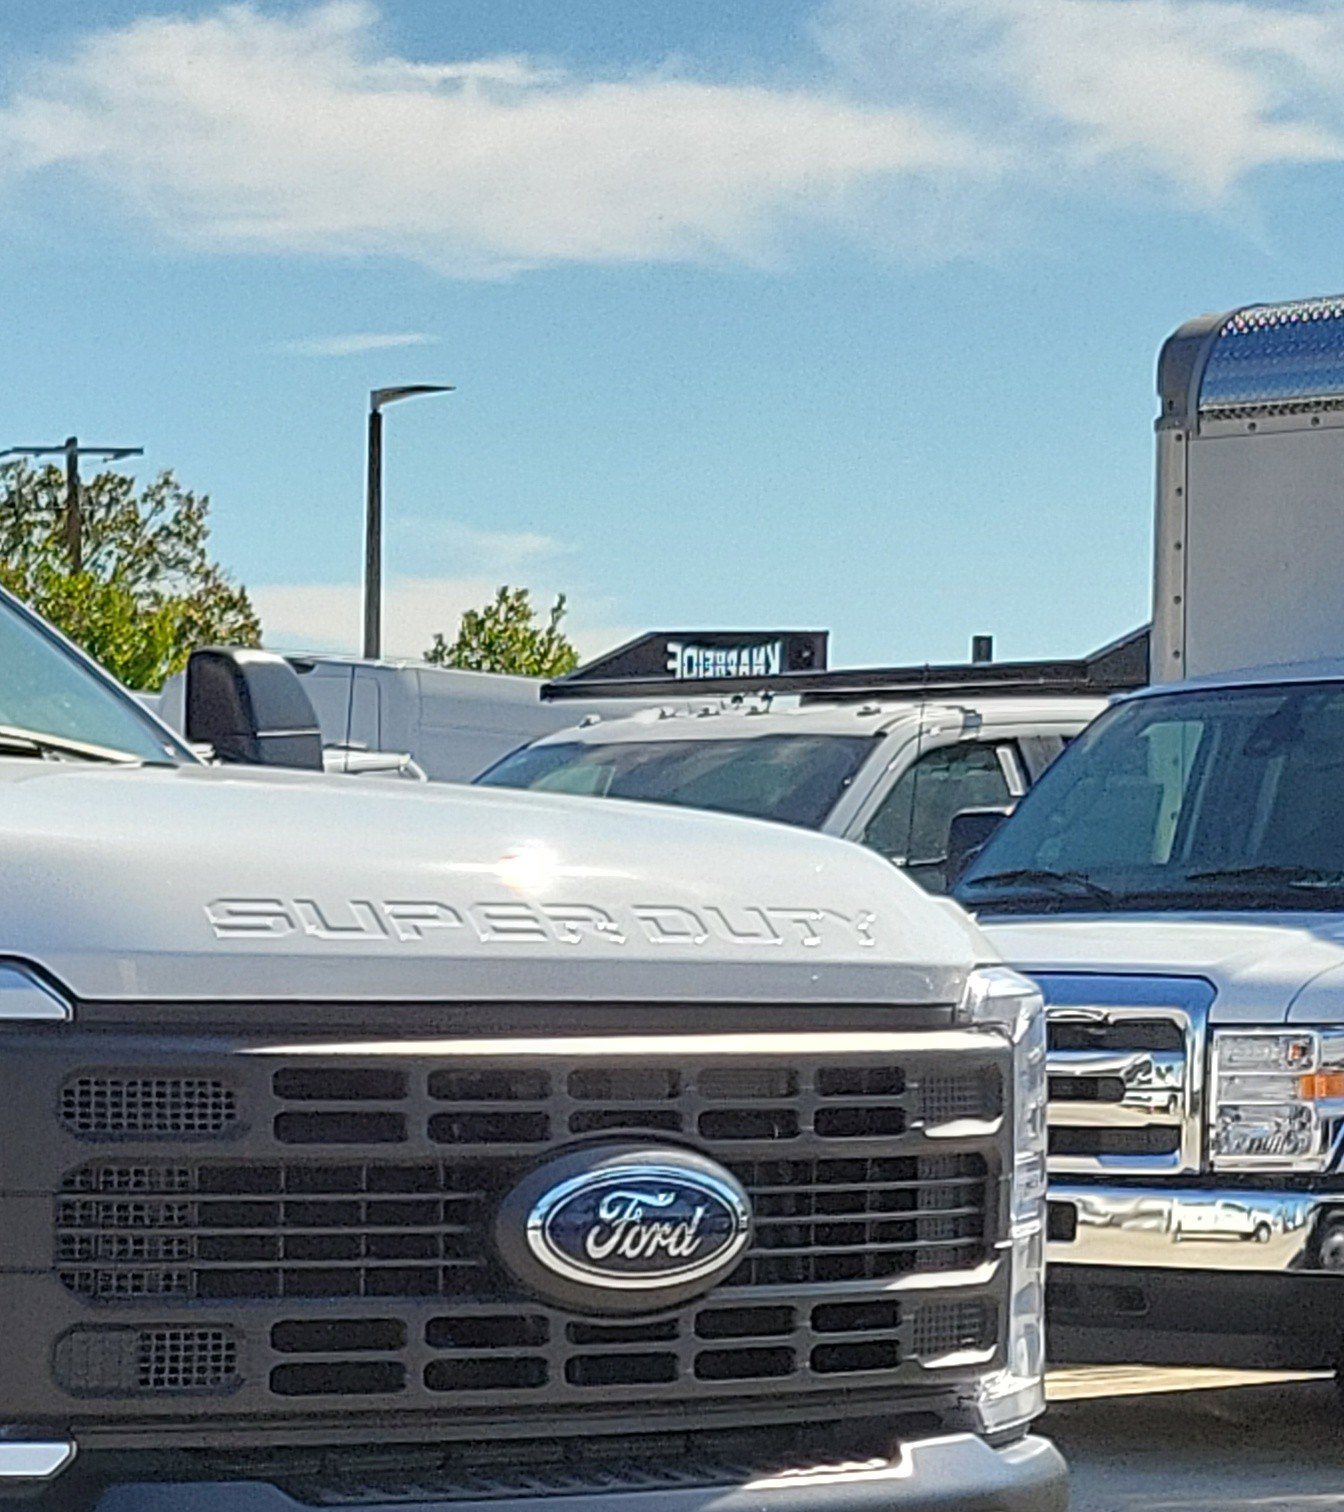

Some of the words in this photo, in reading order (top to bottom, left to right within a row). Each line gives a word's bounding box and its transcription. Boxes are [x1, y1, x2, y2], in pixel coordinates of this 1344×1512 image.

[205, 898, 625, 944] SUPER
[632, 903, 877, 946] DUTY
[586, 1189, 704, 1259] Ford
